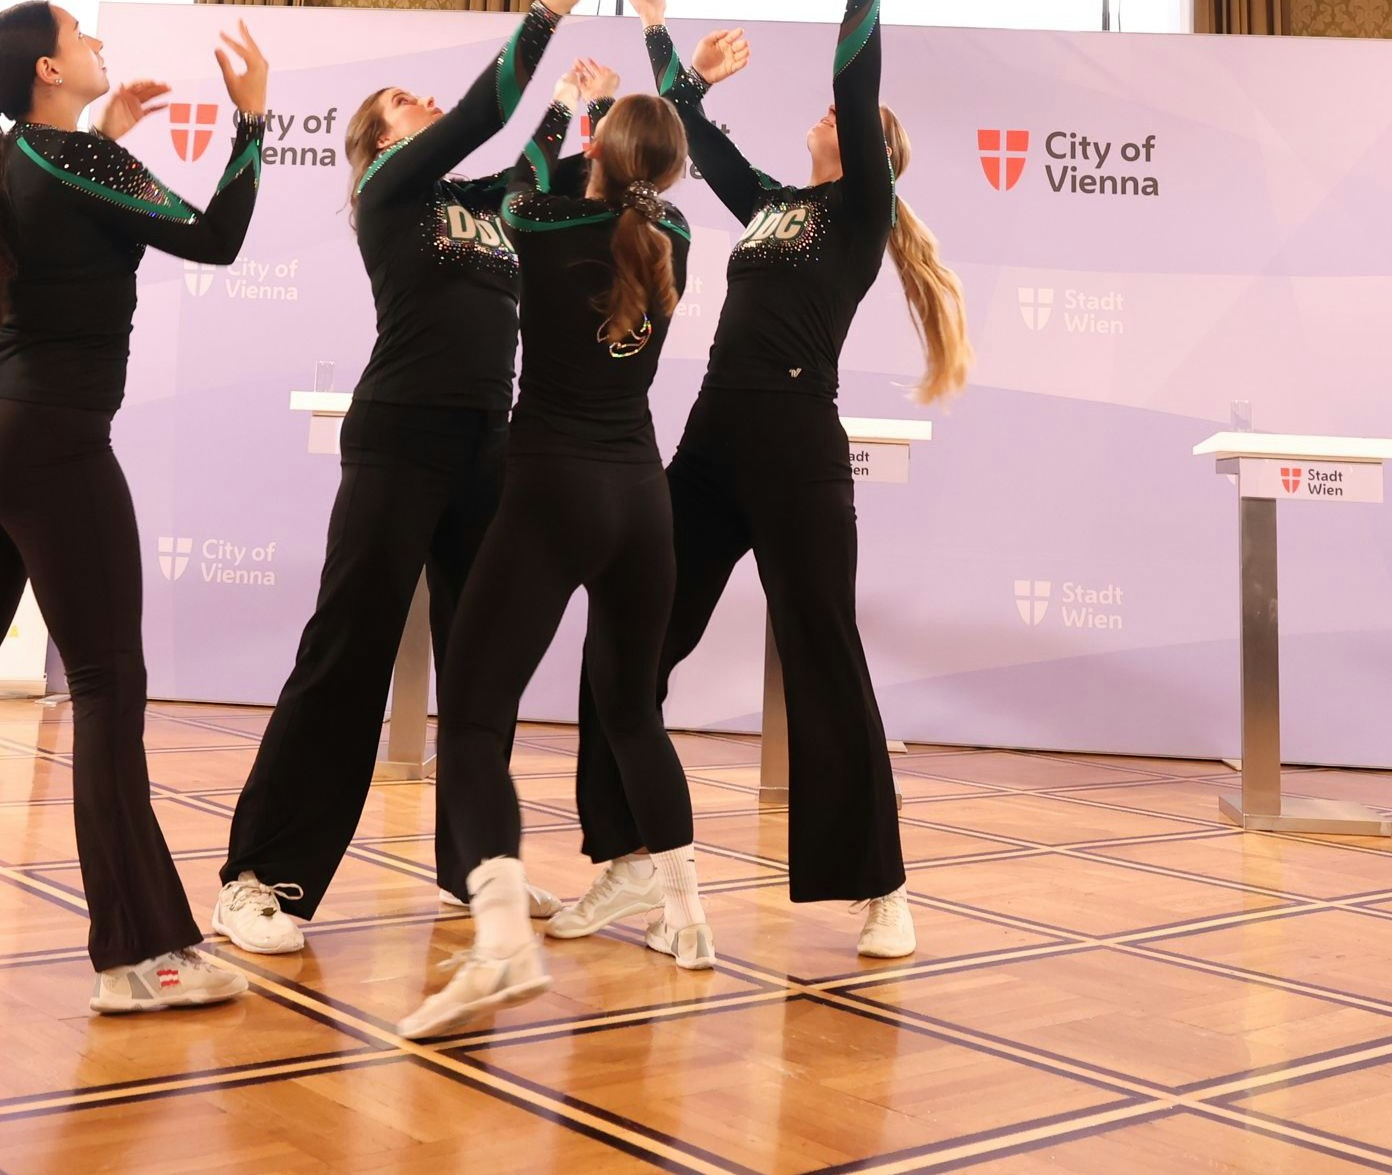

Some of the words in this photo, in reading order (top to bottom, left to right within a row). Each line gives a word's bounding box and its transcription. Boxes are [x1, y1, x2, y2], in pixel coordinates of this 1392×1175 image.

[233, 108, 295, 141] ty
[302, 107, 337, 134] of
[231, 137, 337, 167] enna
[1044, 131, 1112, 169] City
[1120, 134, 1157, 163] of
[1044, 164, 1160, 197] Vienna
[226, 258, 270, 281] City
[274, 259, 300, 278] of
[224, 279, 299, 302] Vienna
[1064, 288, 1126, 311] Stadt
[1064, 312, 1125, 335] Wien
[849, 450, 870, 462] adt
[1307, 468, 1343, 482] Stadt
[1307, 482, 1343, 496] Wien
[202, 538, 247, 566] City
[251, 541, 277, 562] of
[200, 562, 276, 586] Vienna
[1061, 581, 1124, 606] Stadt
[1060, 606, 1123, 629] Wien
